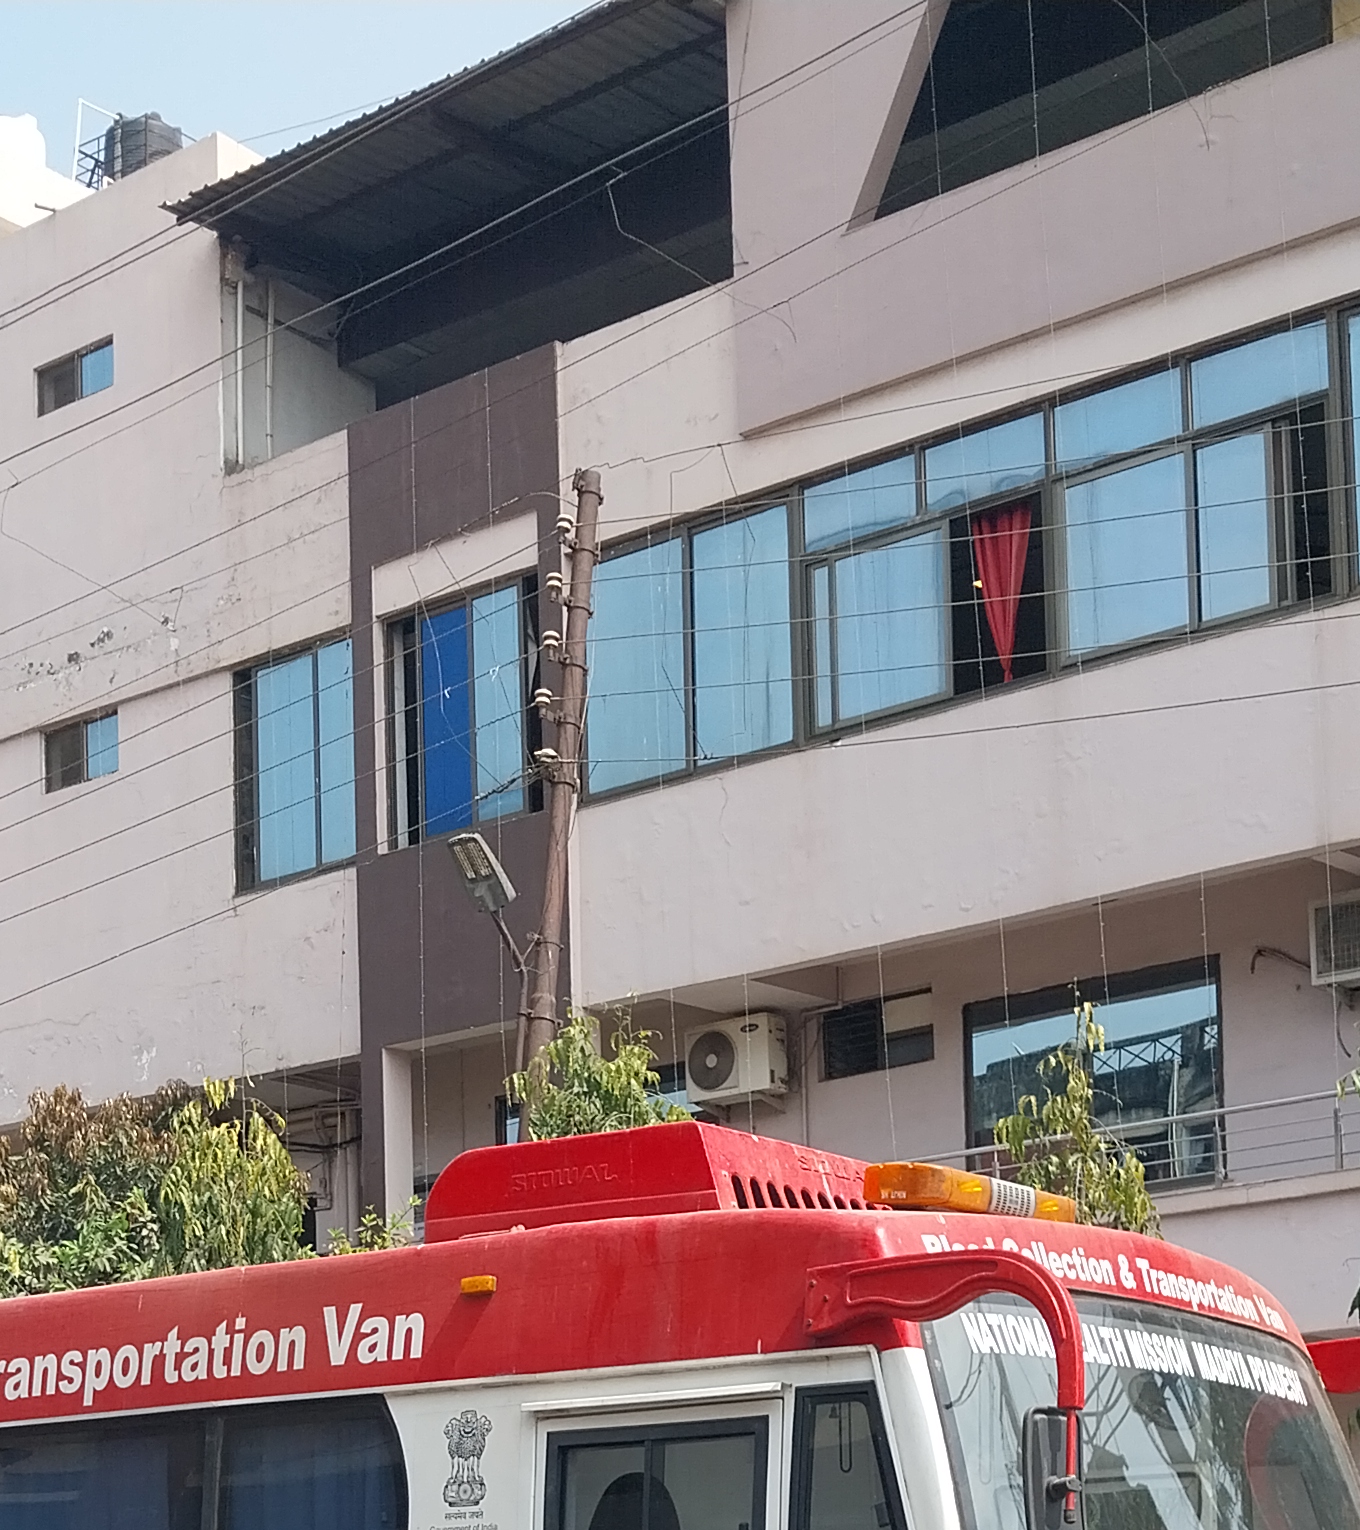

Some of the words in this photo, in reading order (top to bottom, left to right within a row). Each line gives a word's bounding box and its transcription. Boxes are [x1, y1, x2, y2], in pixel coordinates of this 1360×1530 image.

[1117, 1253, 1137, 1290] &
[1135, 1257, 1260, 1323] Transportation
[1252, 1294, 1288, 1333] Van
[323, 1302, 426, 1366] Van
[960, 1312, 1057, 1359] NATIONA
[1124, 1328, 1195, 1378] MISSION
[1191, 1340, 1255, 1391] MADHYA
